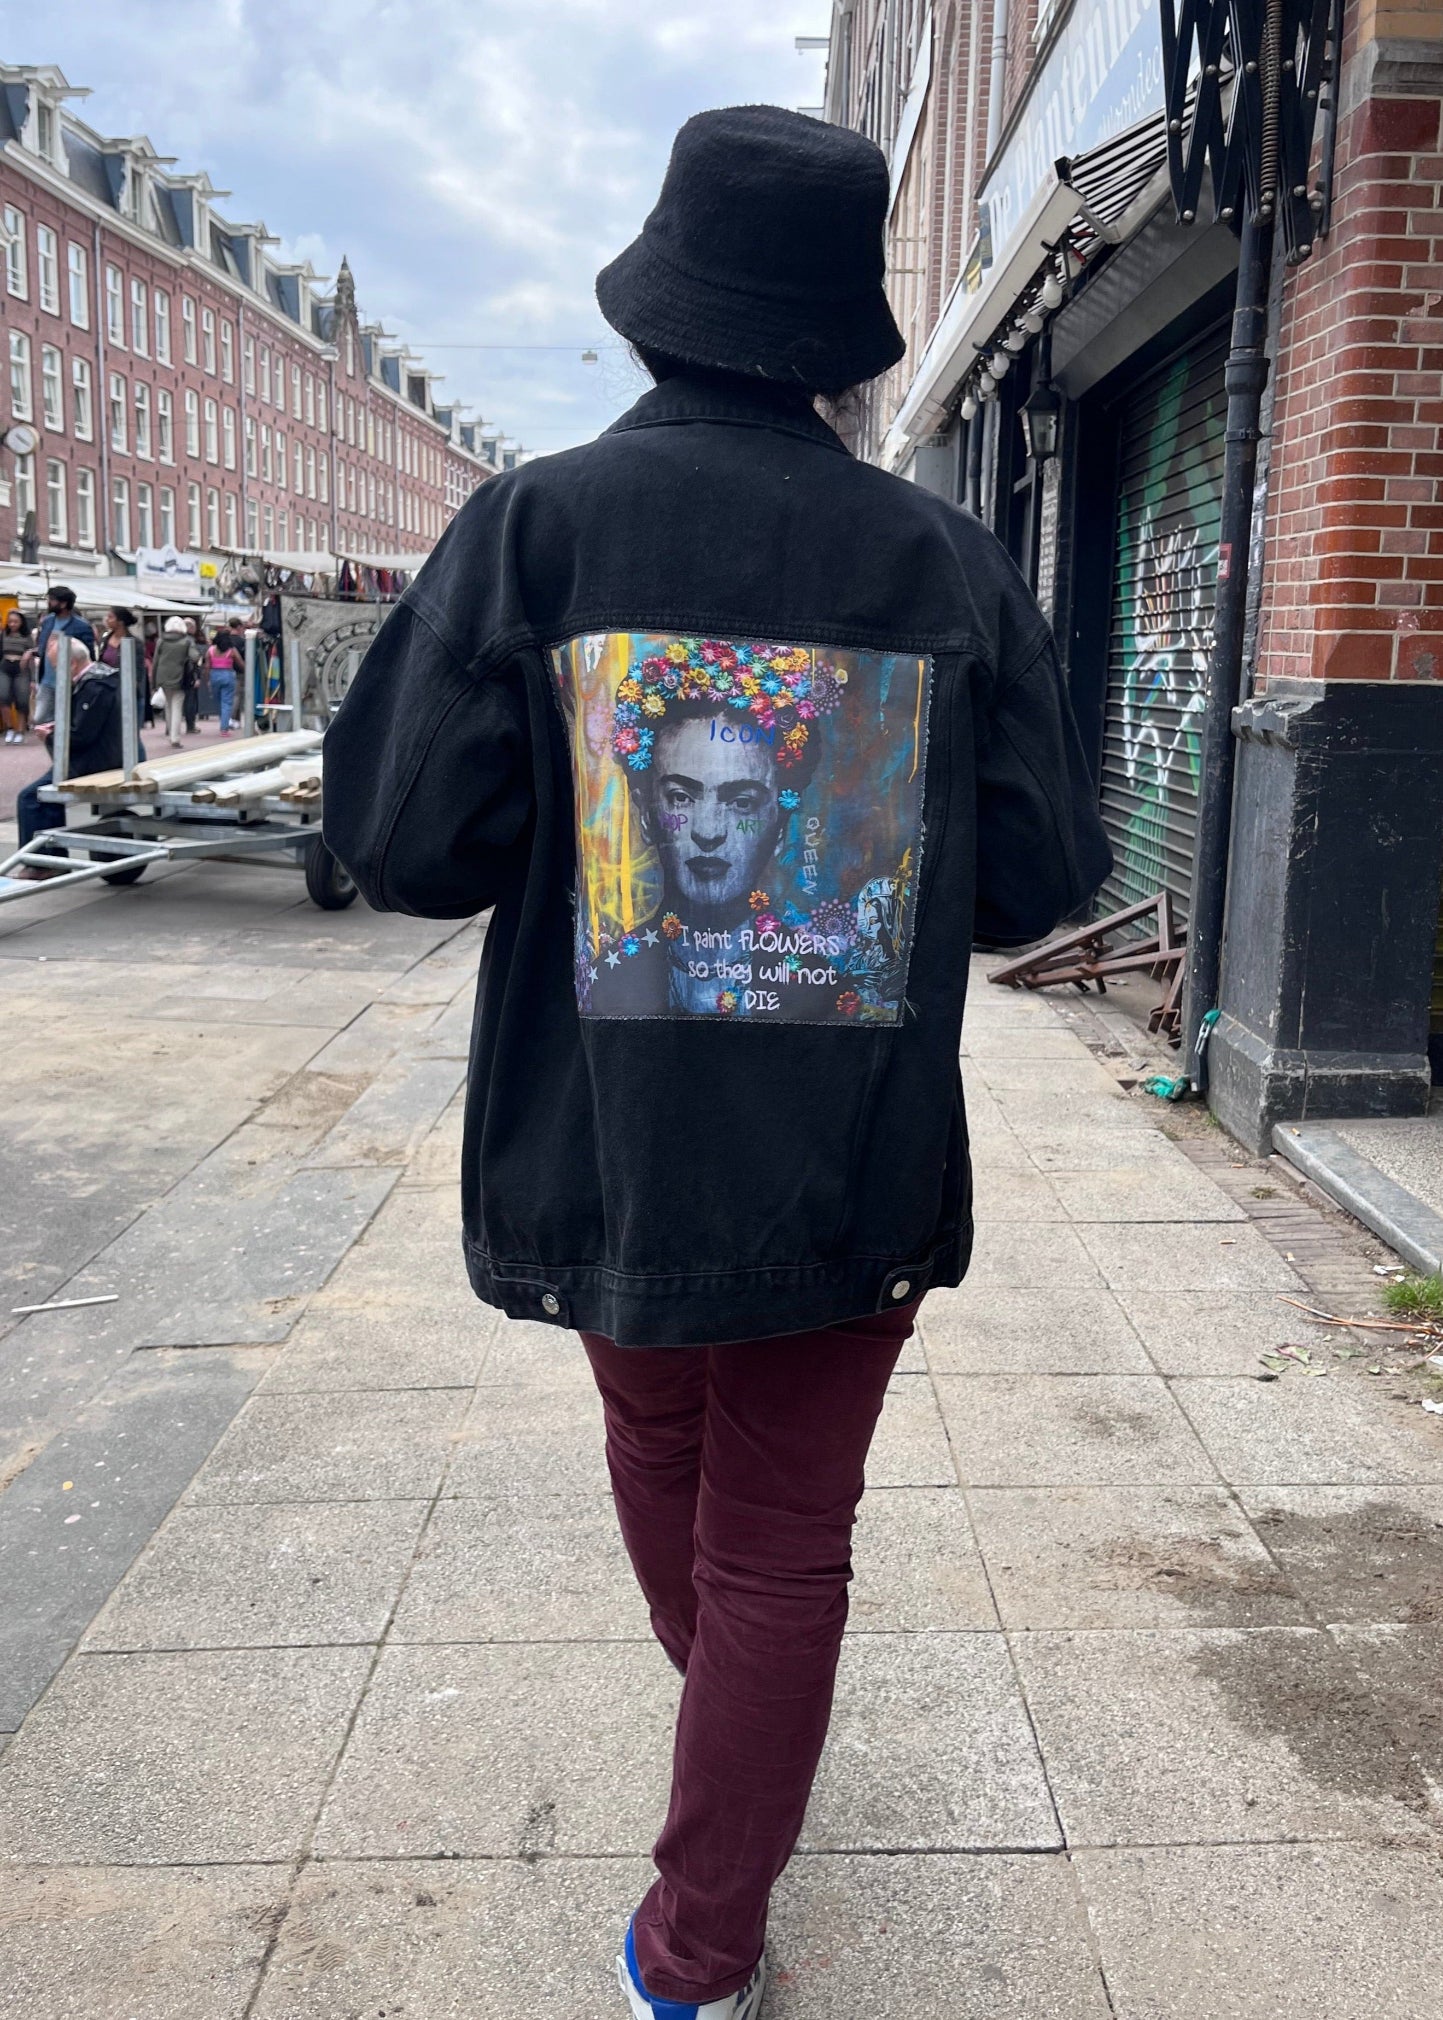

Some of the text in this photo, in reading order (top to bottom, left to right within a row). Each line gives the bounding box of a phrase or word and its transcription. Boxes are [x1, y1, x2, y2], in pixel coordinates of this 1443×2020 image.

[660, 811, 763, 835] POP ART
[802, 816, 820, 895] QUEEN
[681, 925, 840, 956] I paint FLOWERS
[688, 959, 838, 986] so they will not
[744, 990, 781, 1011] DIE
